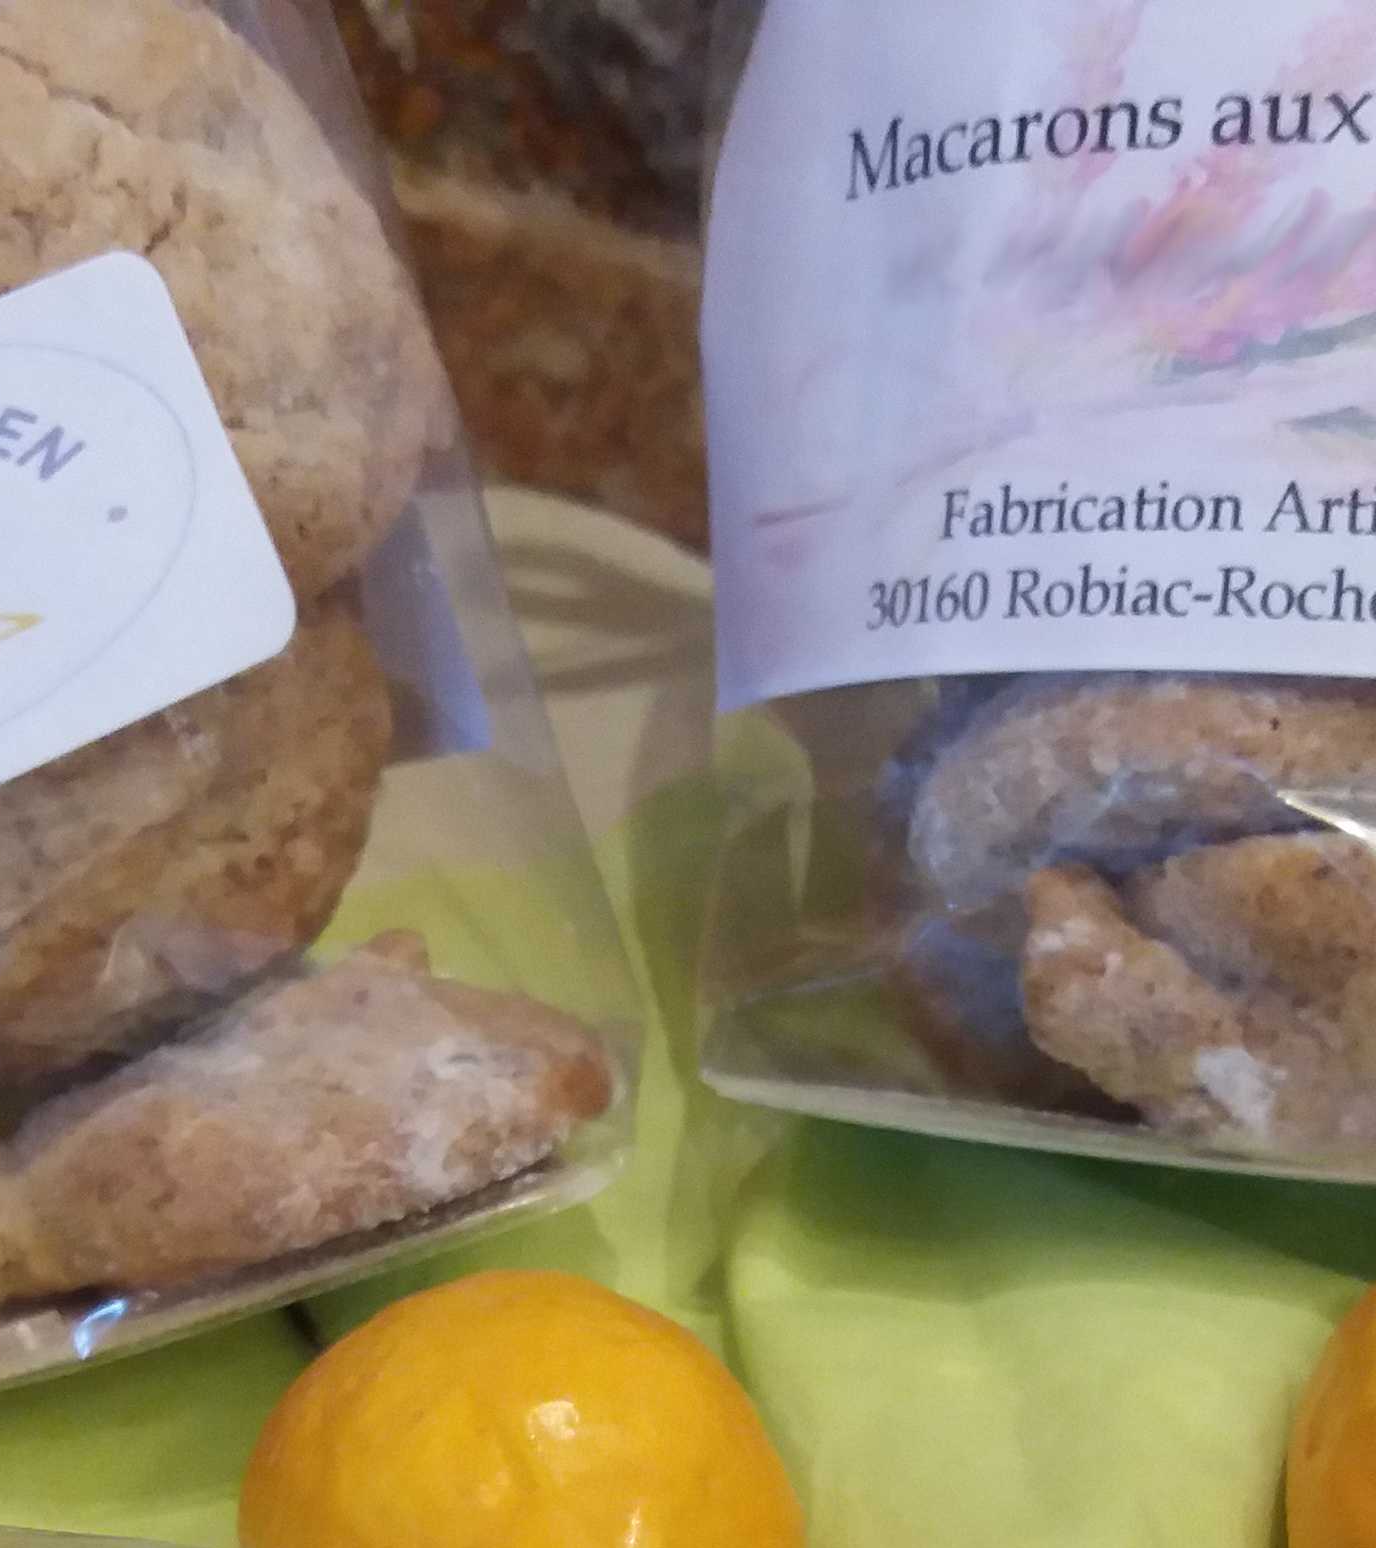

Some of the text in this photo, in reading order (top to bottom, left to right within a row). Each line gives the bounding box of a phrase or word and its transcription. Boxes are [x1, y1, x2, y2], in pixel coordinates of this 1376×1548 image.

[846, 97, 1184, 201] Macarons
[1210, 90, 1374, 148] aux
[939, 480, 1245, 541] Fabrication
[866, 570, 990, 631] 30160
